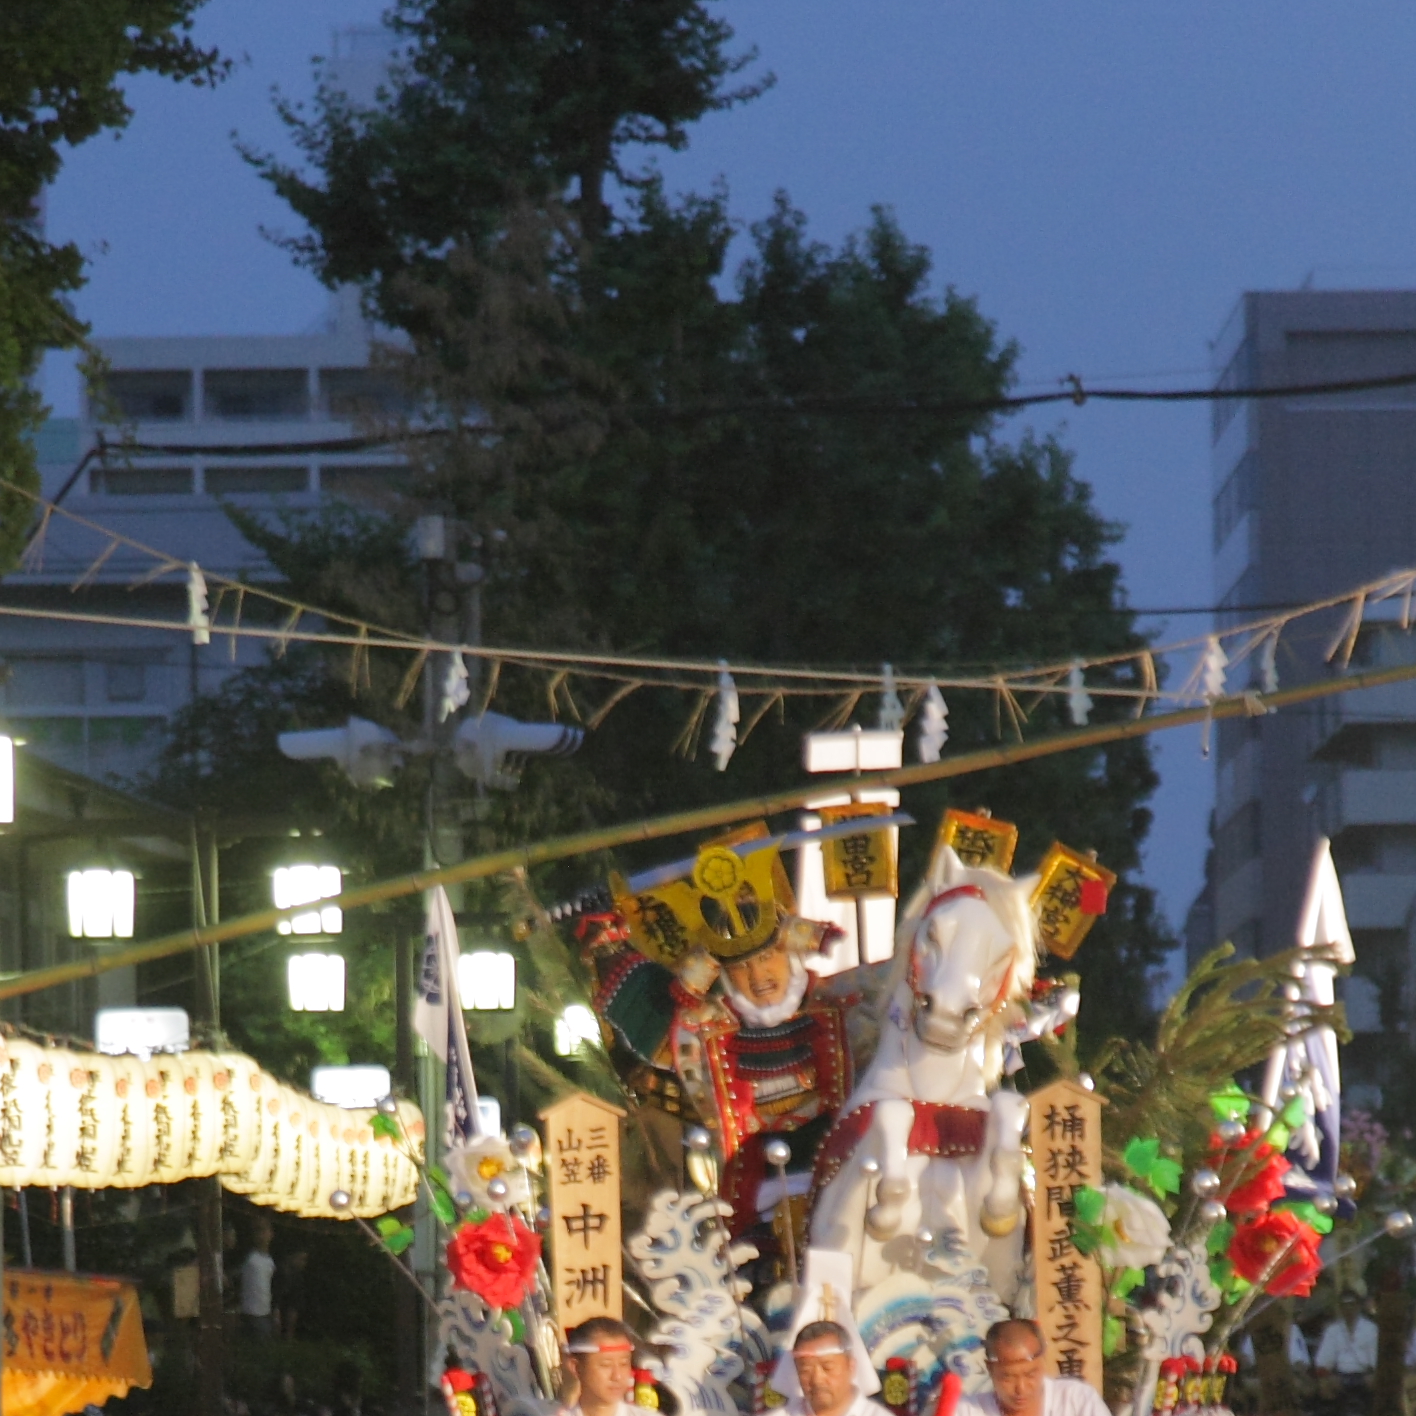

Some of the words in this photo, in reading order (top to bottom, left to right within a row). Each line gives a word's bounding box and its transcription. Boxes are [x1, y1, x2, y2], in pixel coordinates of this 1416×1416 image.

[557, 1127, 584, 1186] 山笠
[586, 1126, 612, 1186] 三番
[562, 1202, 612, 1311] 中洲
